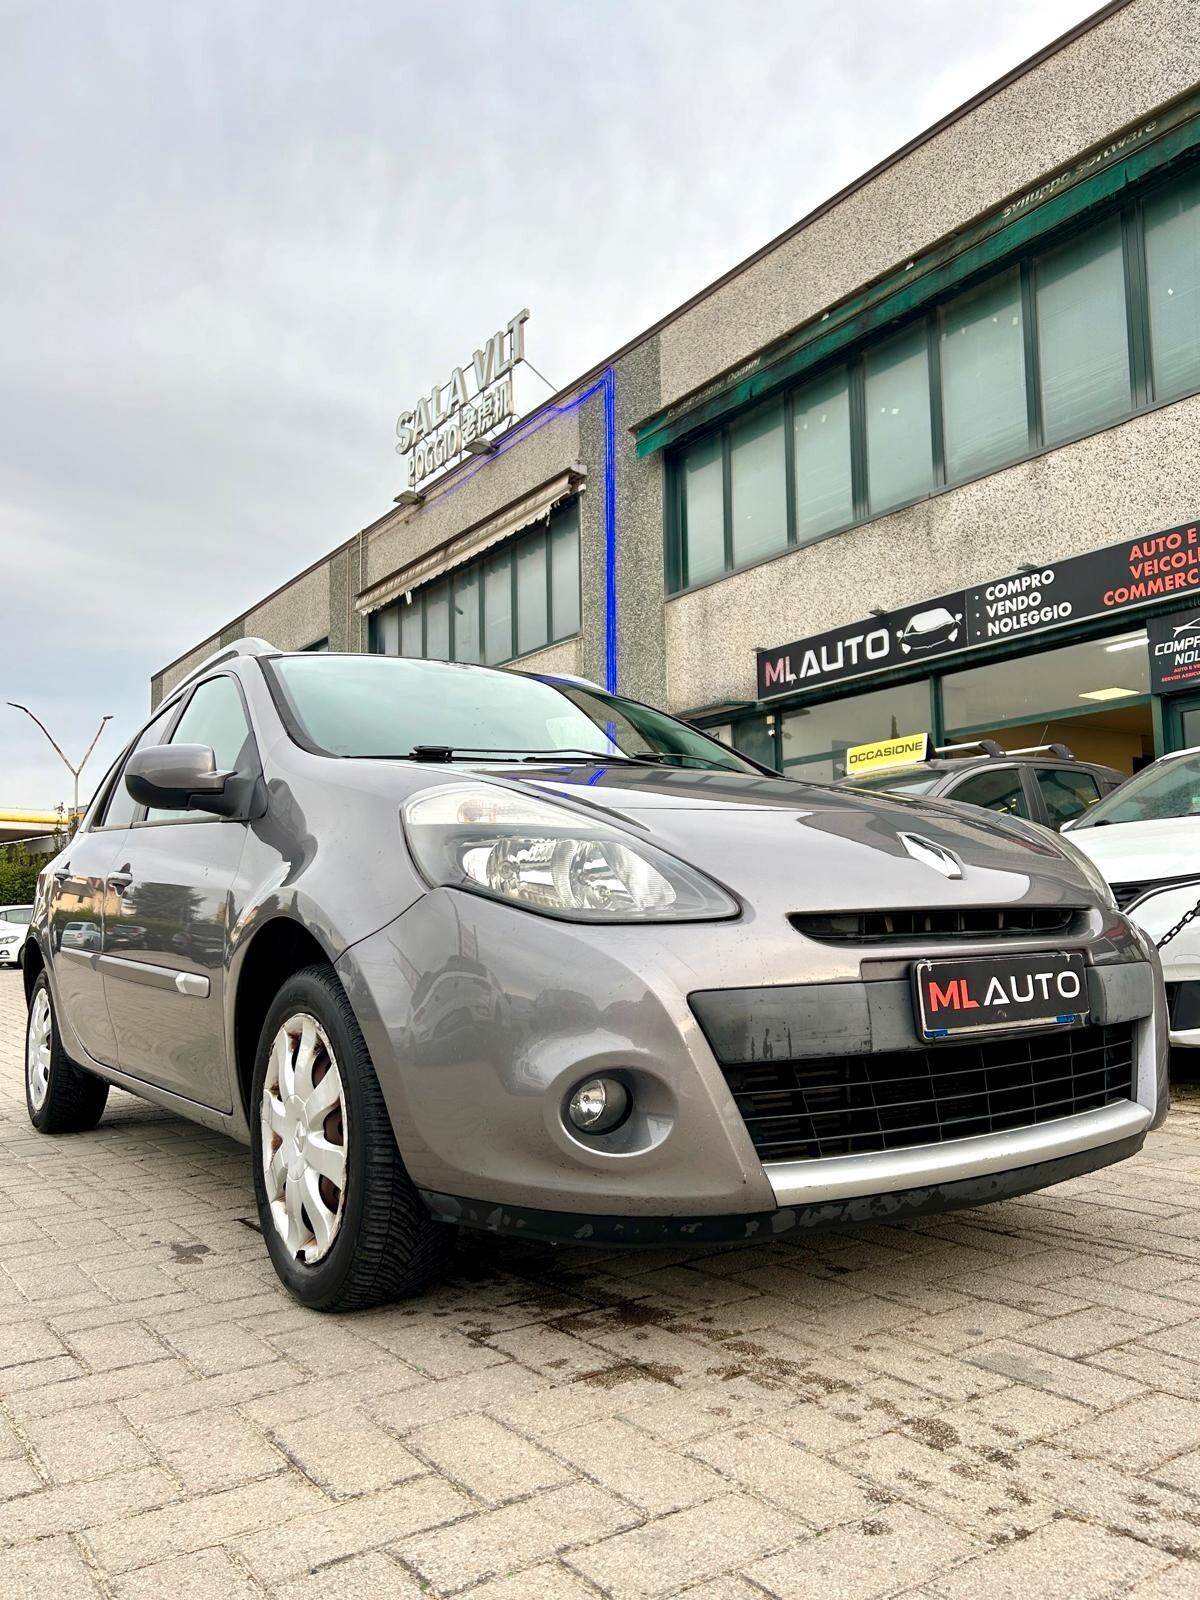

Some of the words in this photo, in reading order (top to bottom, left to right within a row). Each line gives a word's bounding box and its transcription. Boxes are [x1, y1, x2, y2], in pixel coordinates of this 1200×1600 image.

[395, 367, 469, 455] SALA
[472, 308, 530, 392] VLT
[408, 424, 462, 487] POGGIO
[1129, 533, 1182, 561] AUTO
[1187, 528, 1198, 545] E
[985, 569, 1055, 601] COMPRO
[985, 591, 1042, 618] VENDO
[987, 601, 1073, 637] NOLEGGIO
[849, 741, 924, 764] OCCASIONE
